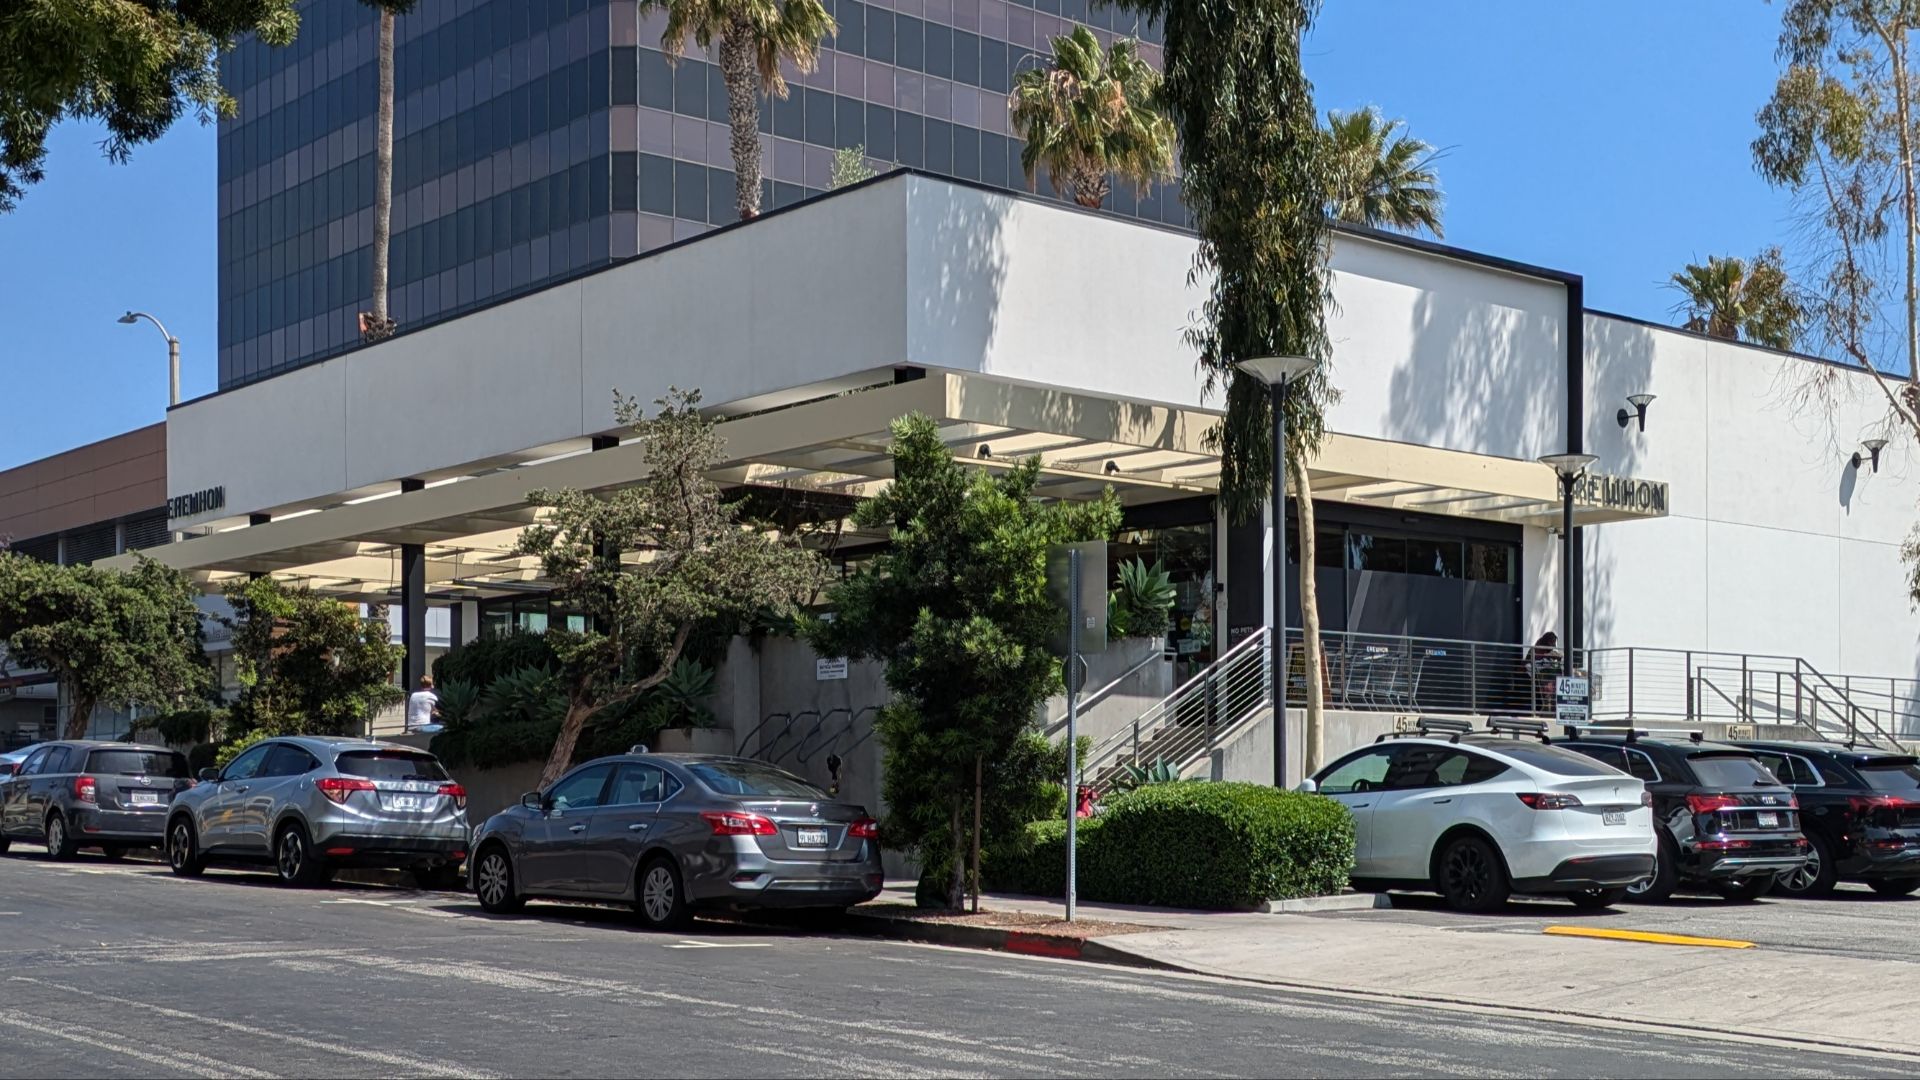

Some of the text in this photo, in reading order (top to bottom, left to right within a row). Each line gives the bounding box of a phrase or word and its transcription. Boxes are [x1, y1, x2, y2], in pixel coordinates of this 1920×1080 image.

[1560, 474, 1665, 511] REWHON
[167, 485, 223, 519] EREWHON
[1559, 679, 1570, 695] 45
[1396, 716, 1408, 733] 45
[1728, 726, 1738, 740] 45
